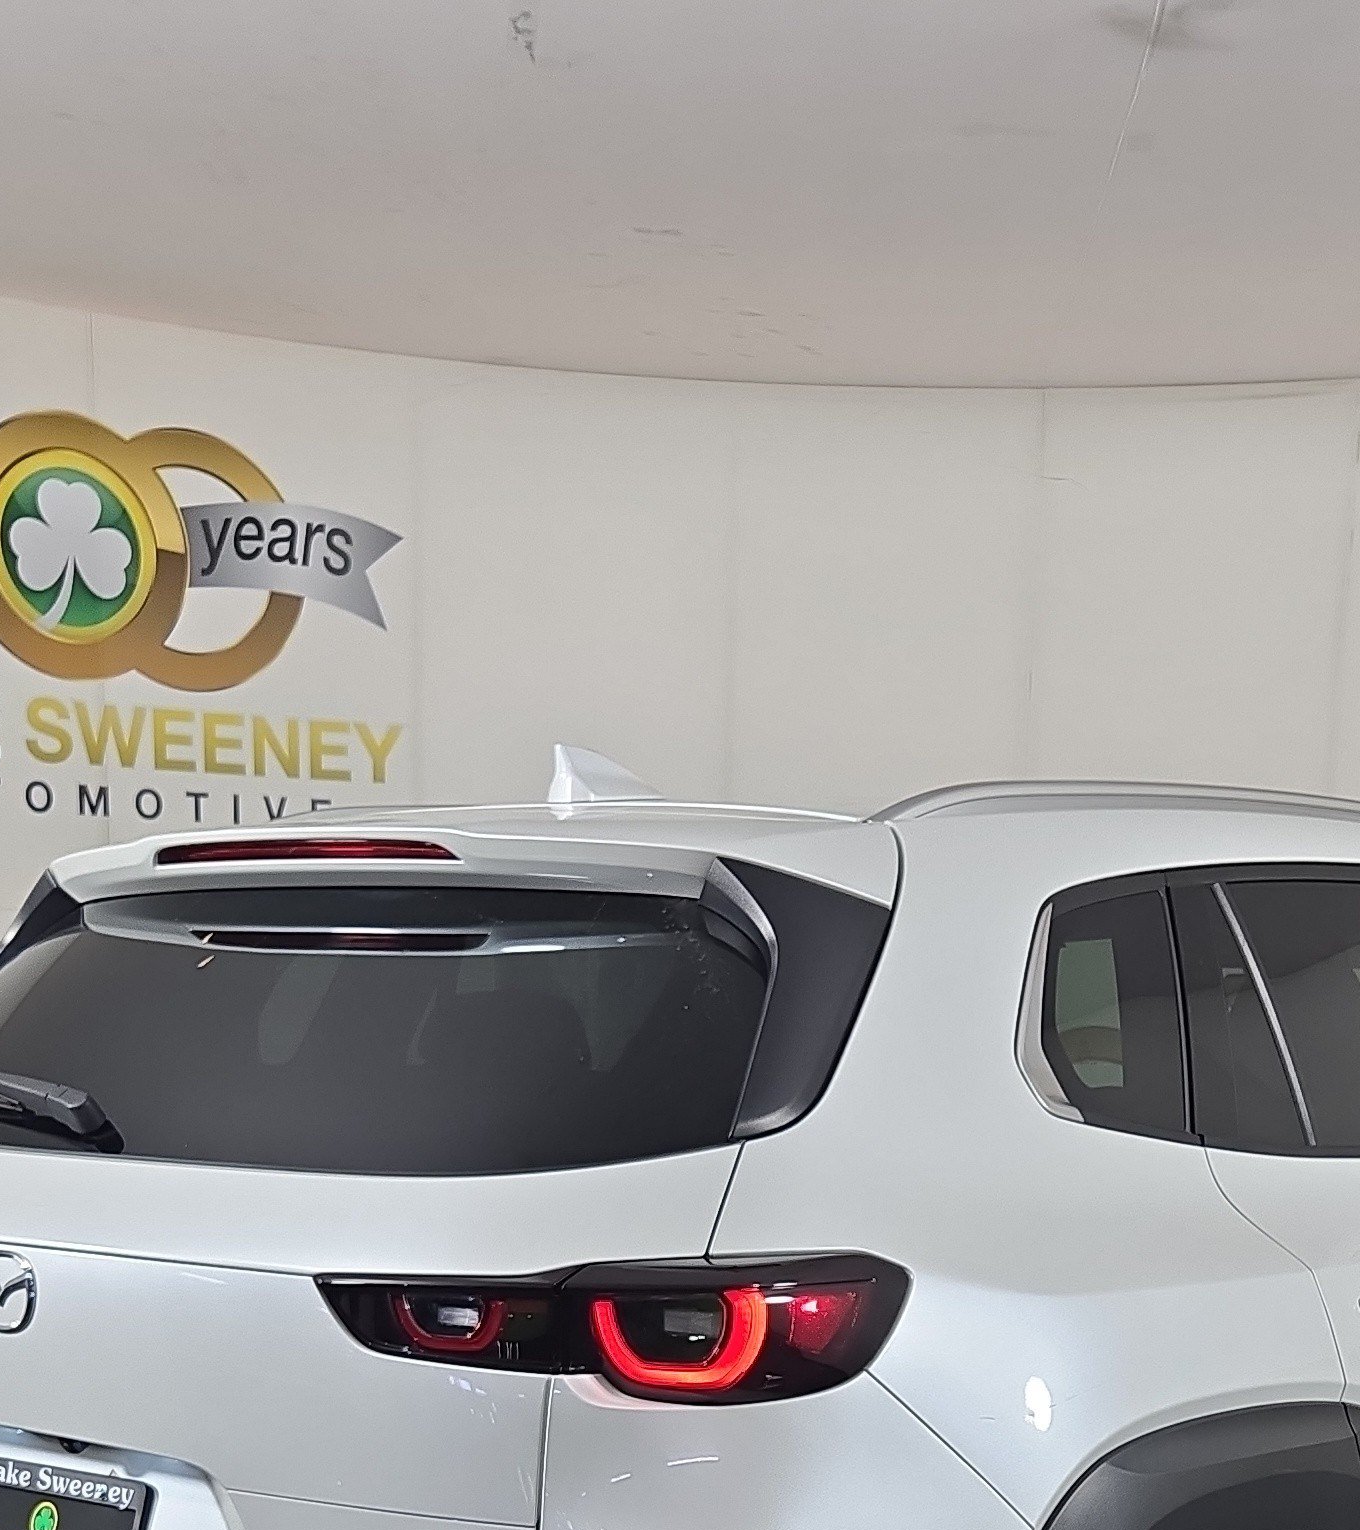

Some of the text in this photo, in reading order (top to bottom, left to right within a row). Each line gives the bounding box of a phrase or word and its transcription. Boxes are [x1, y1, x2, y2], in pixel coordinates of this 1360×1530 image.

[199, 511, 354, 577] years
[25, 697, 403, 784] SWEENEY
[37, 1467, 135, 1510] Sweeney
